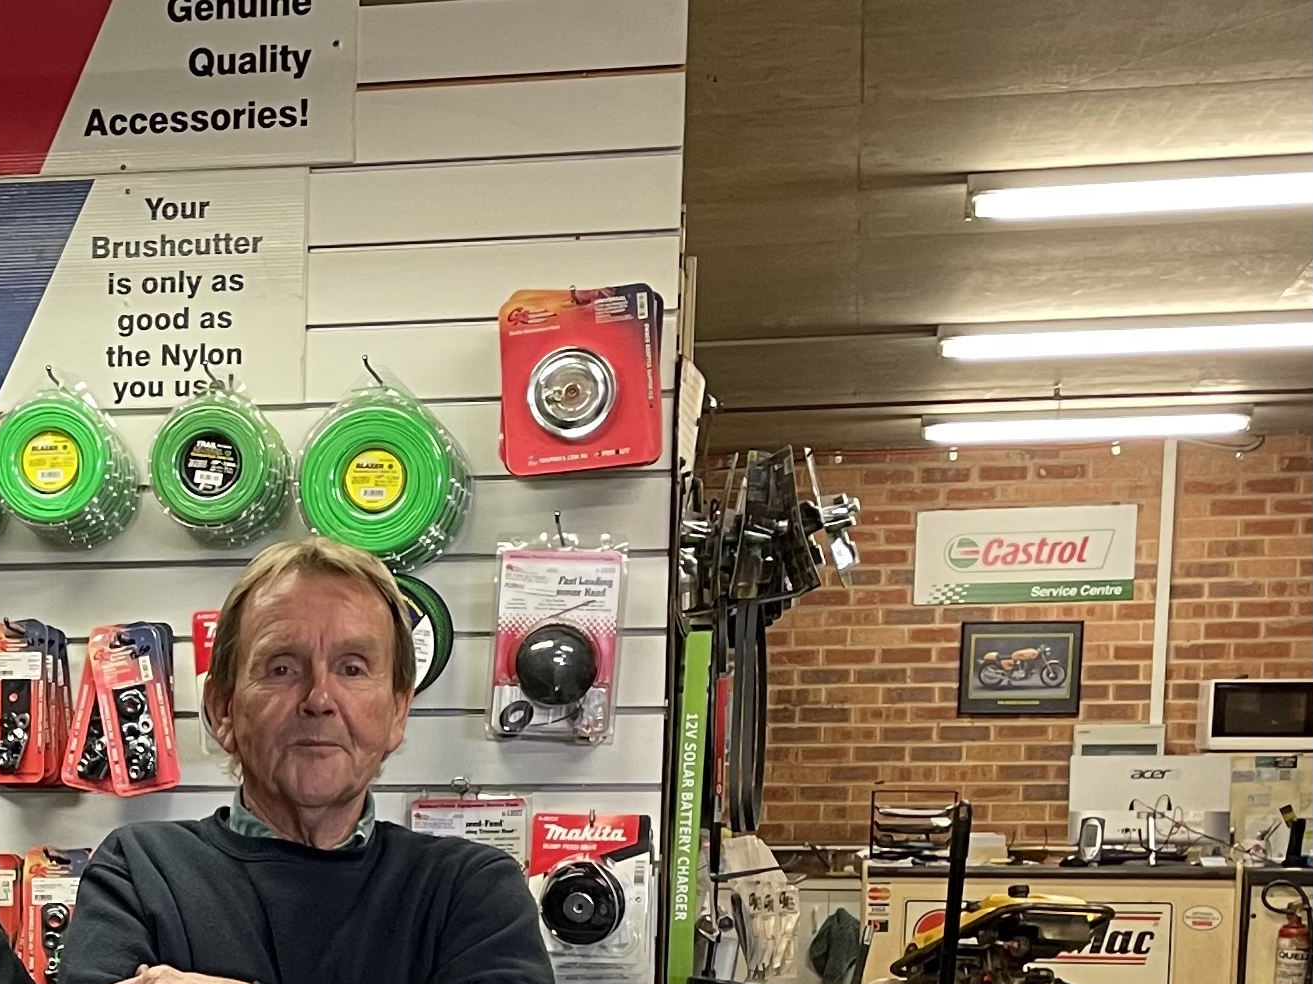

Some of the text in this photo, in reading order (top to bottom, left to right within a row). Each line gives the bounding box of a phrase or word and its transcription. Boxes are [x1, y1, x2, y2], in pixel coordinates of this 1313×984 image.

[167, 0, 312, 23] Genuine
[188, 44, 312, 79] Quality
[84, 98, 308, 137] Accessories!
[145, 197, 210, 220] Your
[92, 233, 263, 259] Brushcutter
[108, 271, 244, 299] is only as
[117, 307, 233, 337] good as
[106, 343, 242, 372] the Nylon
[113, 381, 164, 404] you
[981, 536, 1090, 567] Castrol
[1030, 584, 1123, 597] Service Centre
[1130, 768, 1172, 780] acer
[674, 713, 698, 921] 12V SOLAR BATTERY CHARGER
